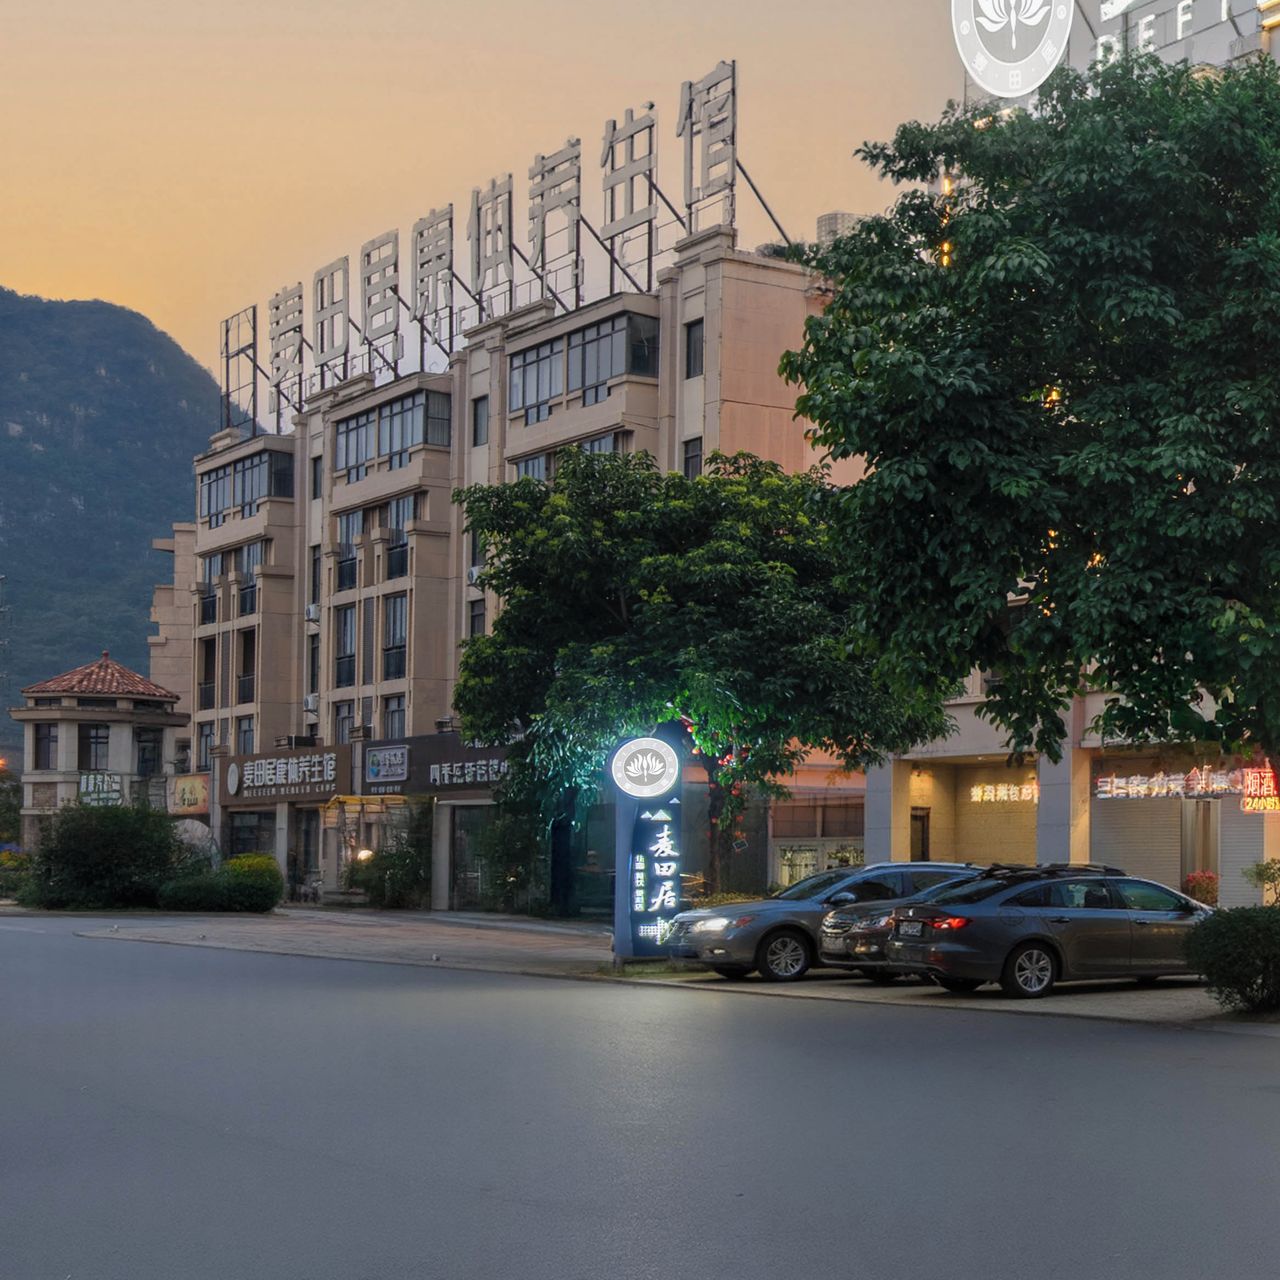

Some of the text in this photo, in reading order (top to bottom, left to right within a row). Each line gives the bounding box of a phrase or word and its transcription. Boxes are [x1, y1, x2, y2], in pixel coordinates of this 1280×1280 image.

[1246, 771, 1277, 797] 烟酒
[647, 824, 681, 912] 麦田居
